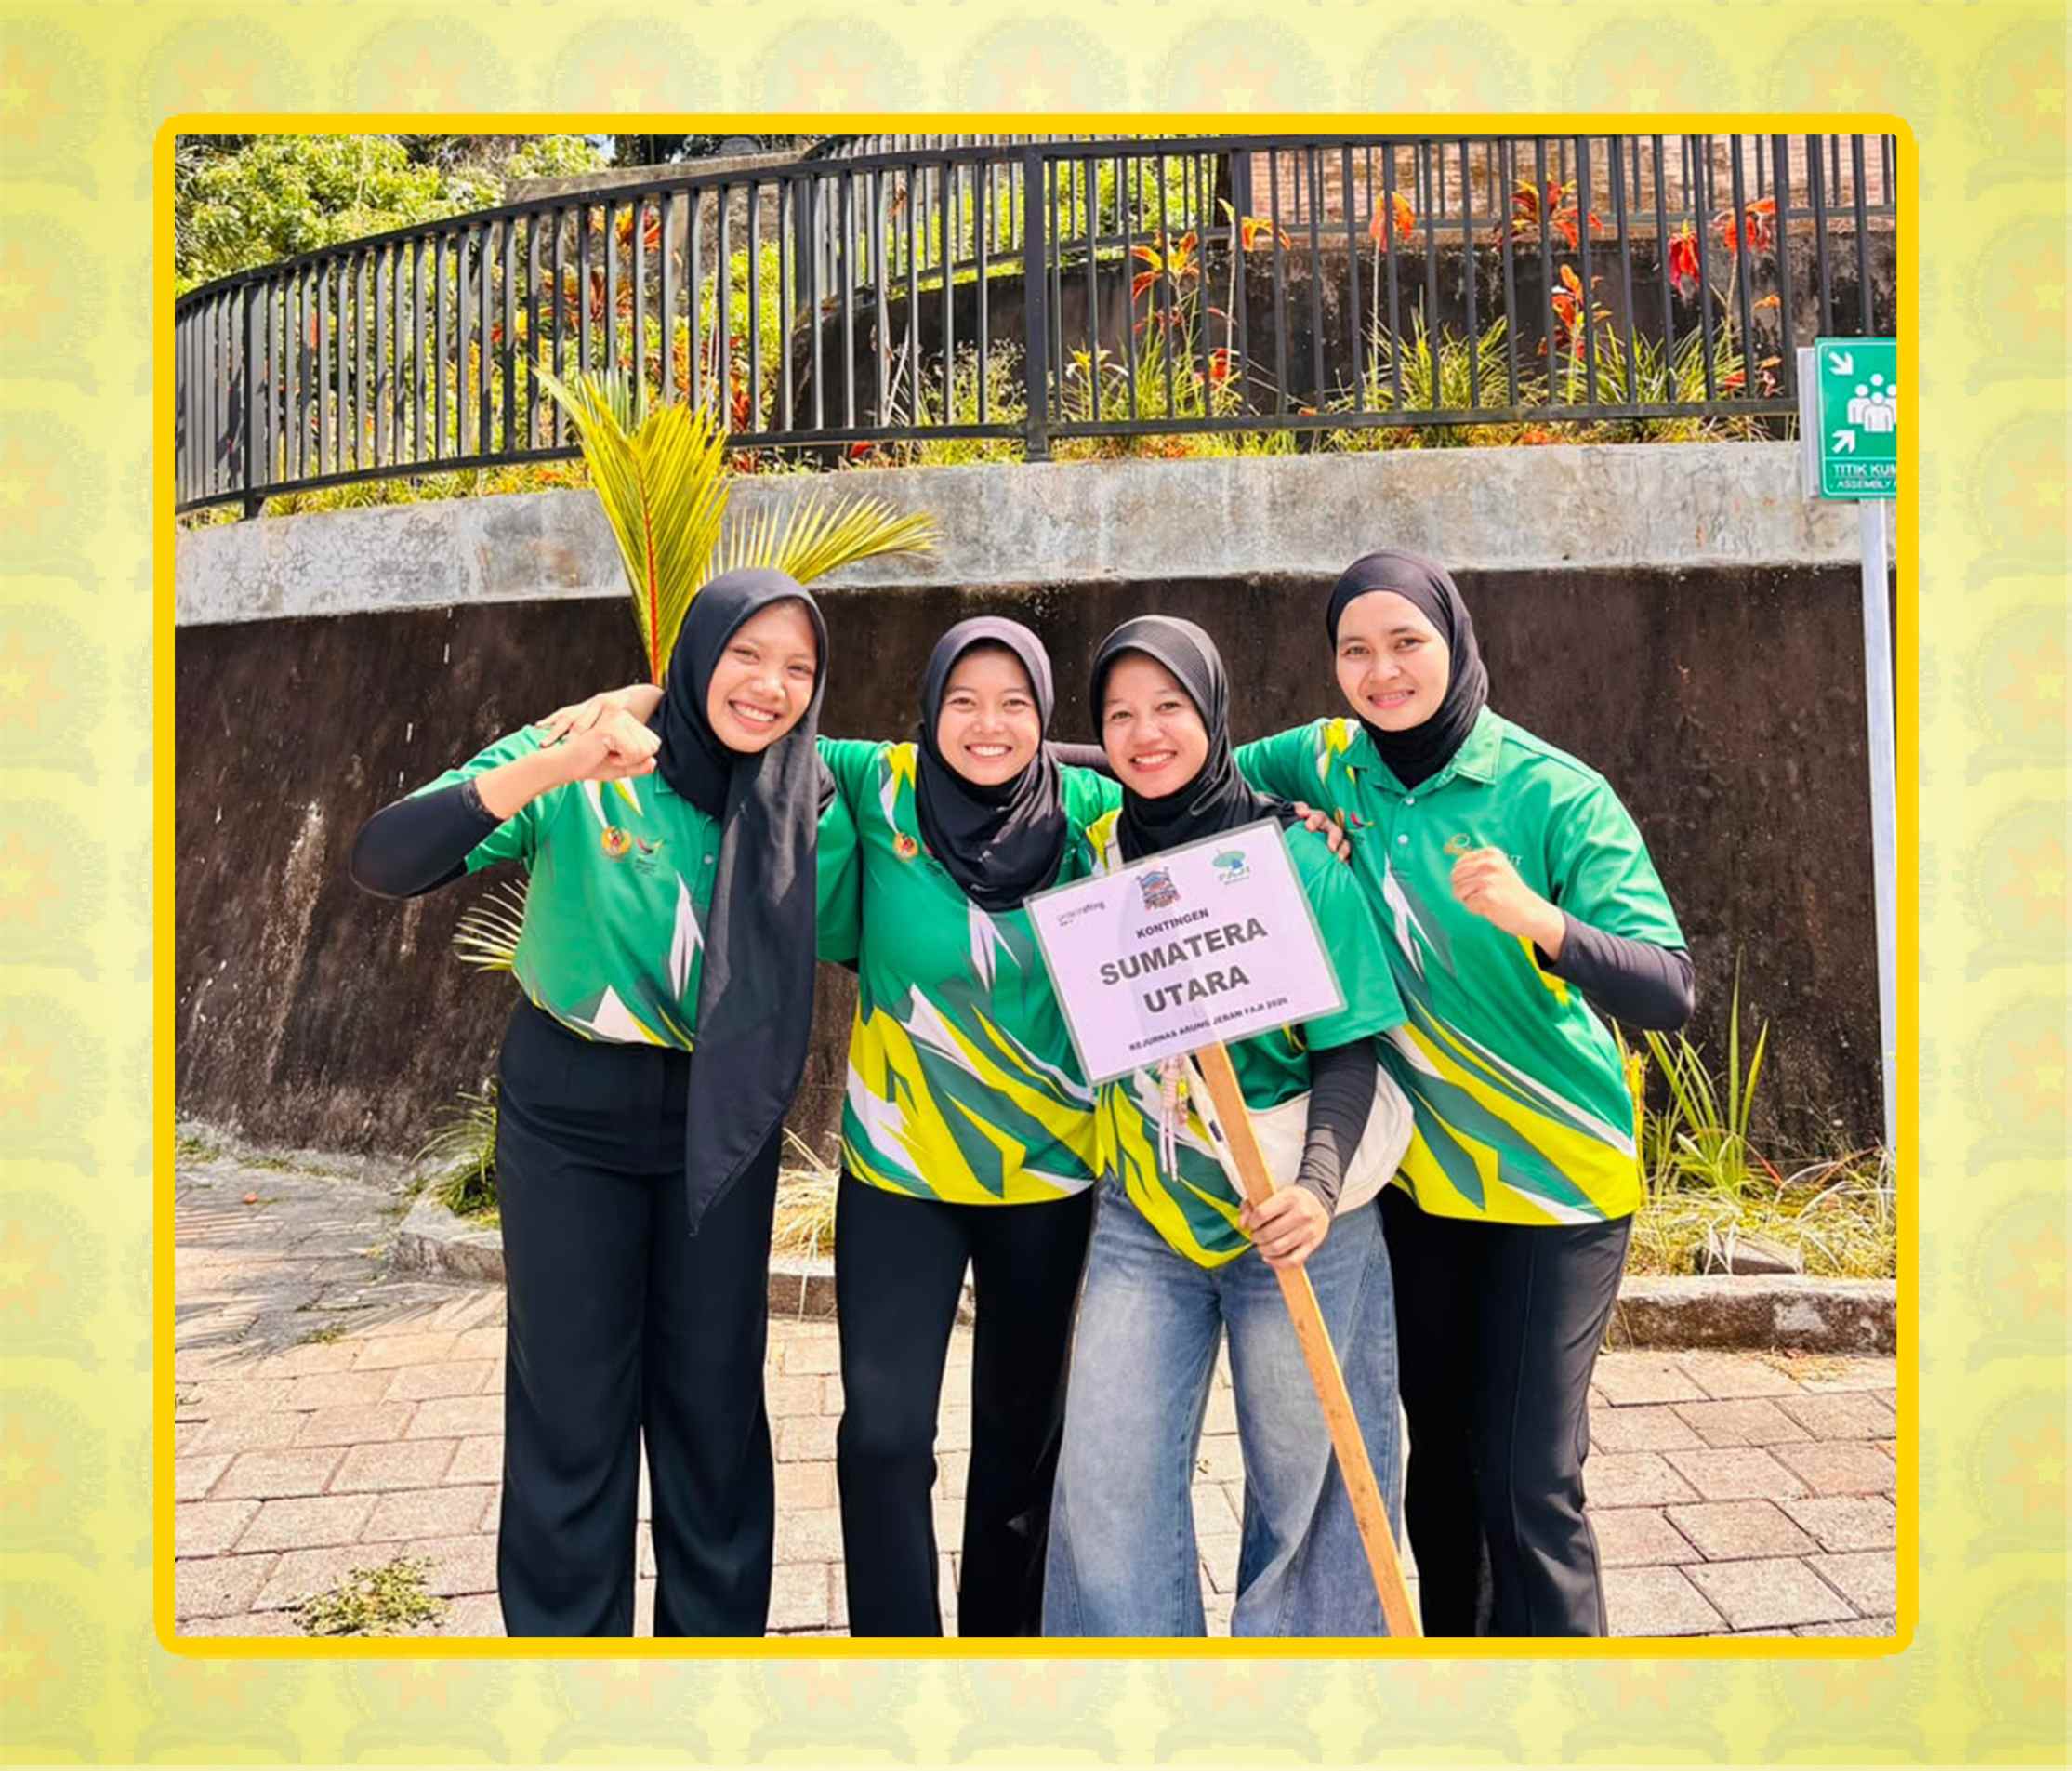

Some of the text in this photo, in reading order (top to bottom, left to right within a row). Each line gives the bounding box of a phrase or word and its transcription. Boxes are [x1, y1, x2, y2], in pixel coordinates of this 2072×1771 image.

[1834, 464, 1867, 476] TITIK
[1837, 480, 1890, 489] ASSEMBLY
[1135, 908, 1209, 938] KONTINGEN
[1100, 917, 1268, 985] SUMATERA
[1142, 965, 1250, 1013] UTARA
[1129, 1030, 1178, 1051] KEJURNAS
[1179, 1020, 1211, 1035] ARUNG
[1212, 1010, 1243, 1024] JERAM
